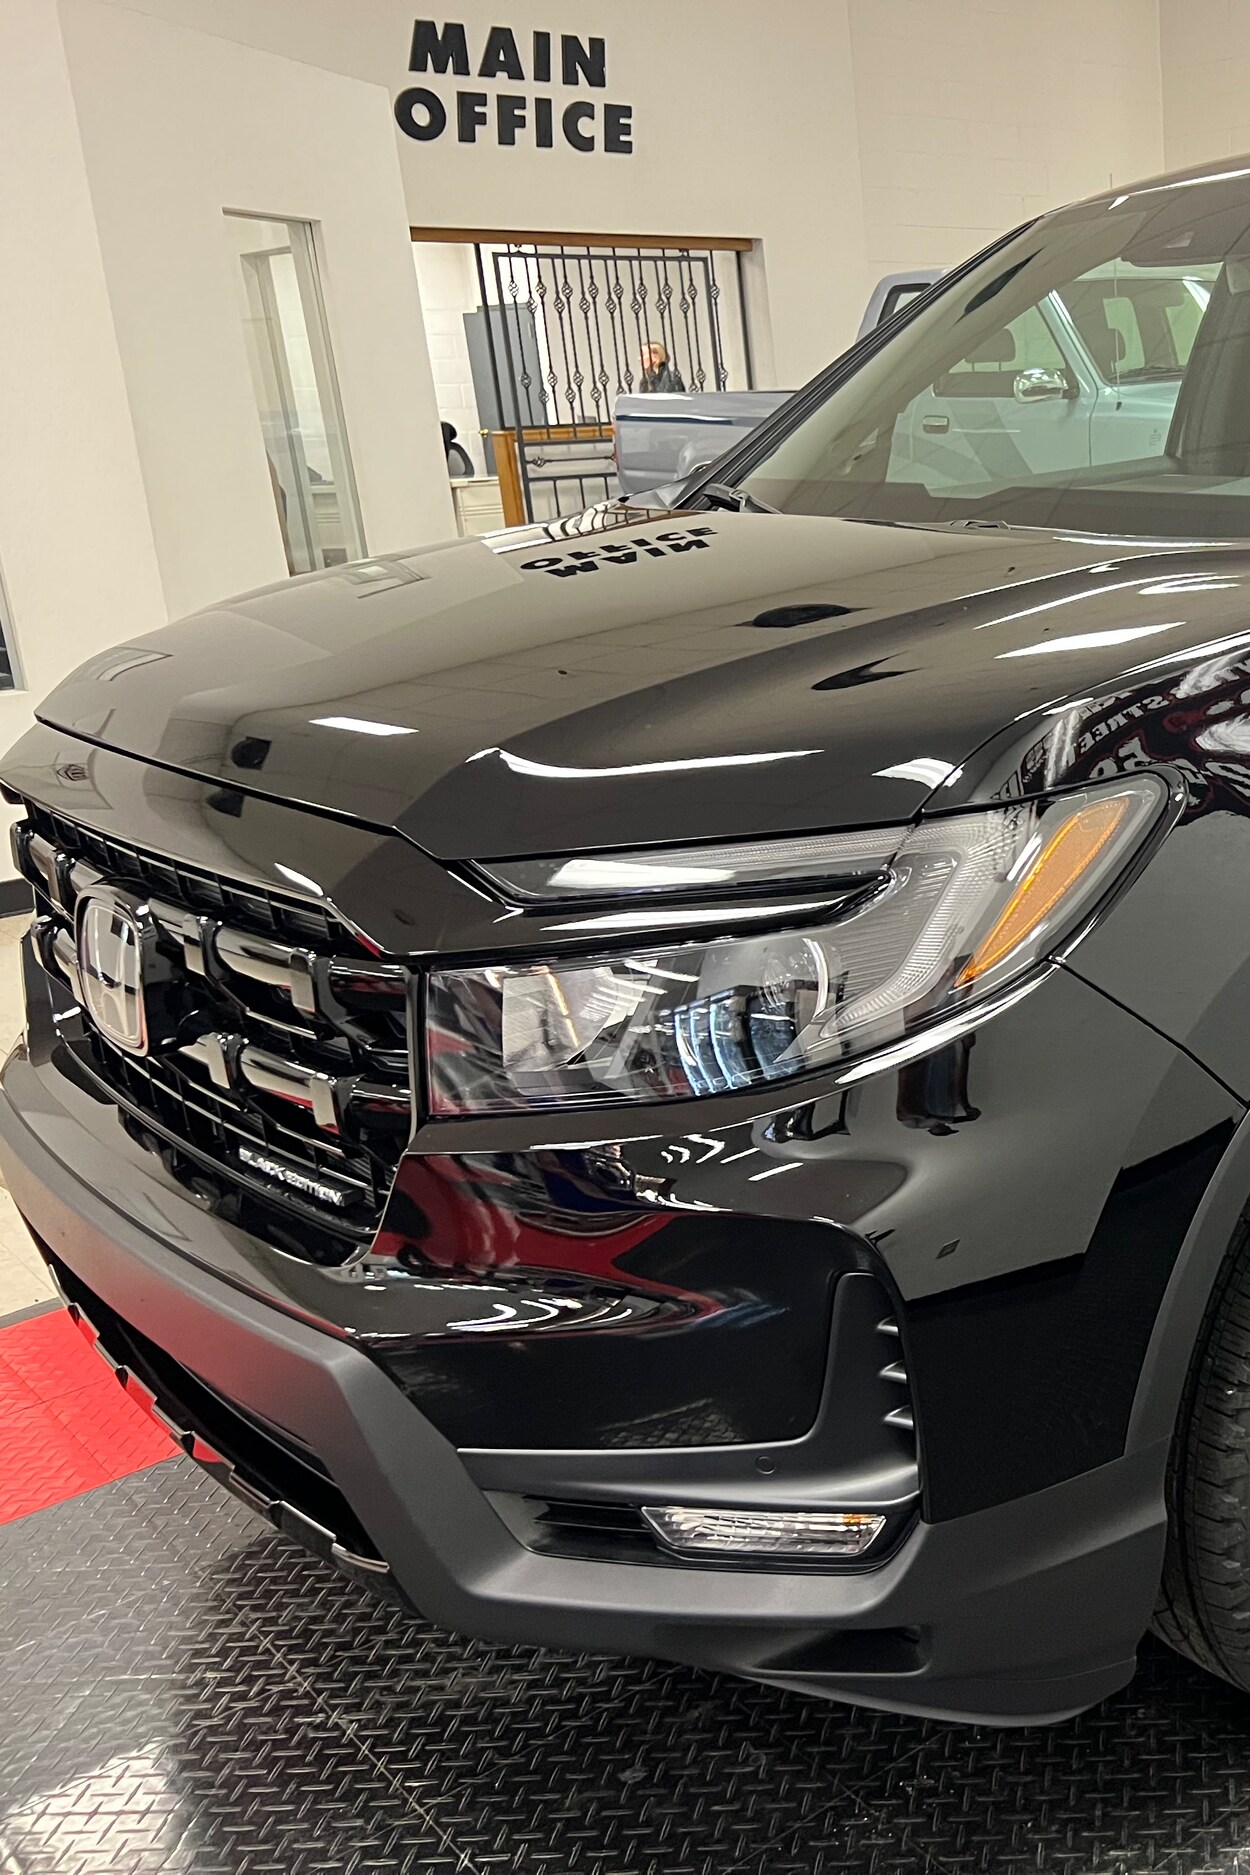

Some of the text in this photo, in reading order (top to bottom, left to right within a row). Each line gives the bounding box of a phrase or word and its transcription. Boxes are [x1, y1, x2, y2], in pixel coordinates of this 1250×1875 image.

[408, 19, 606, 87] MAIN
[394, 87, 632, 153] OFFICE
[239, 1147, 343, 1206] BLACK EDITION
